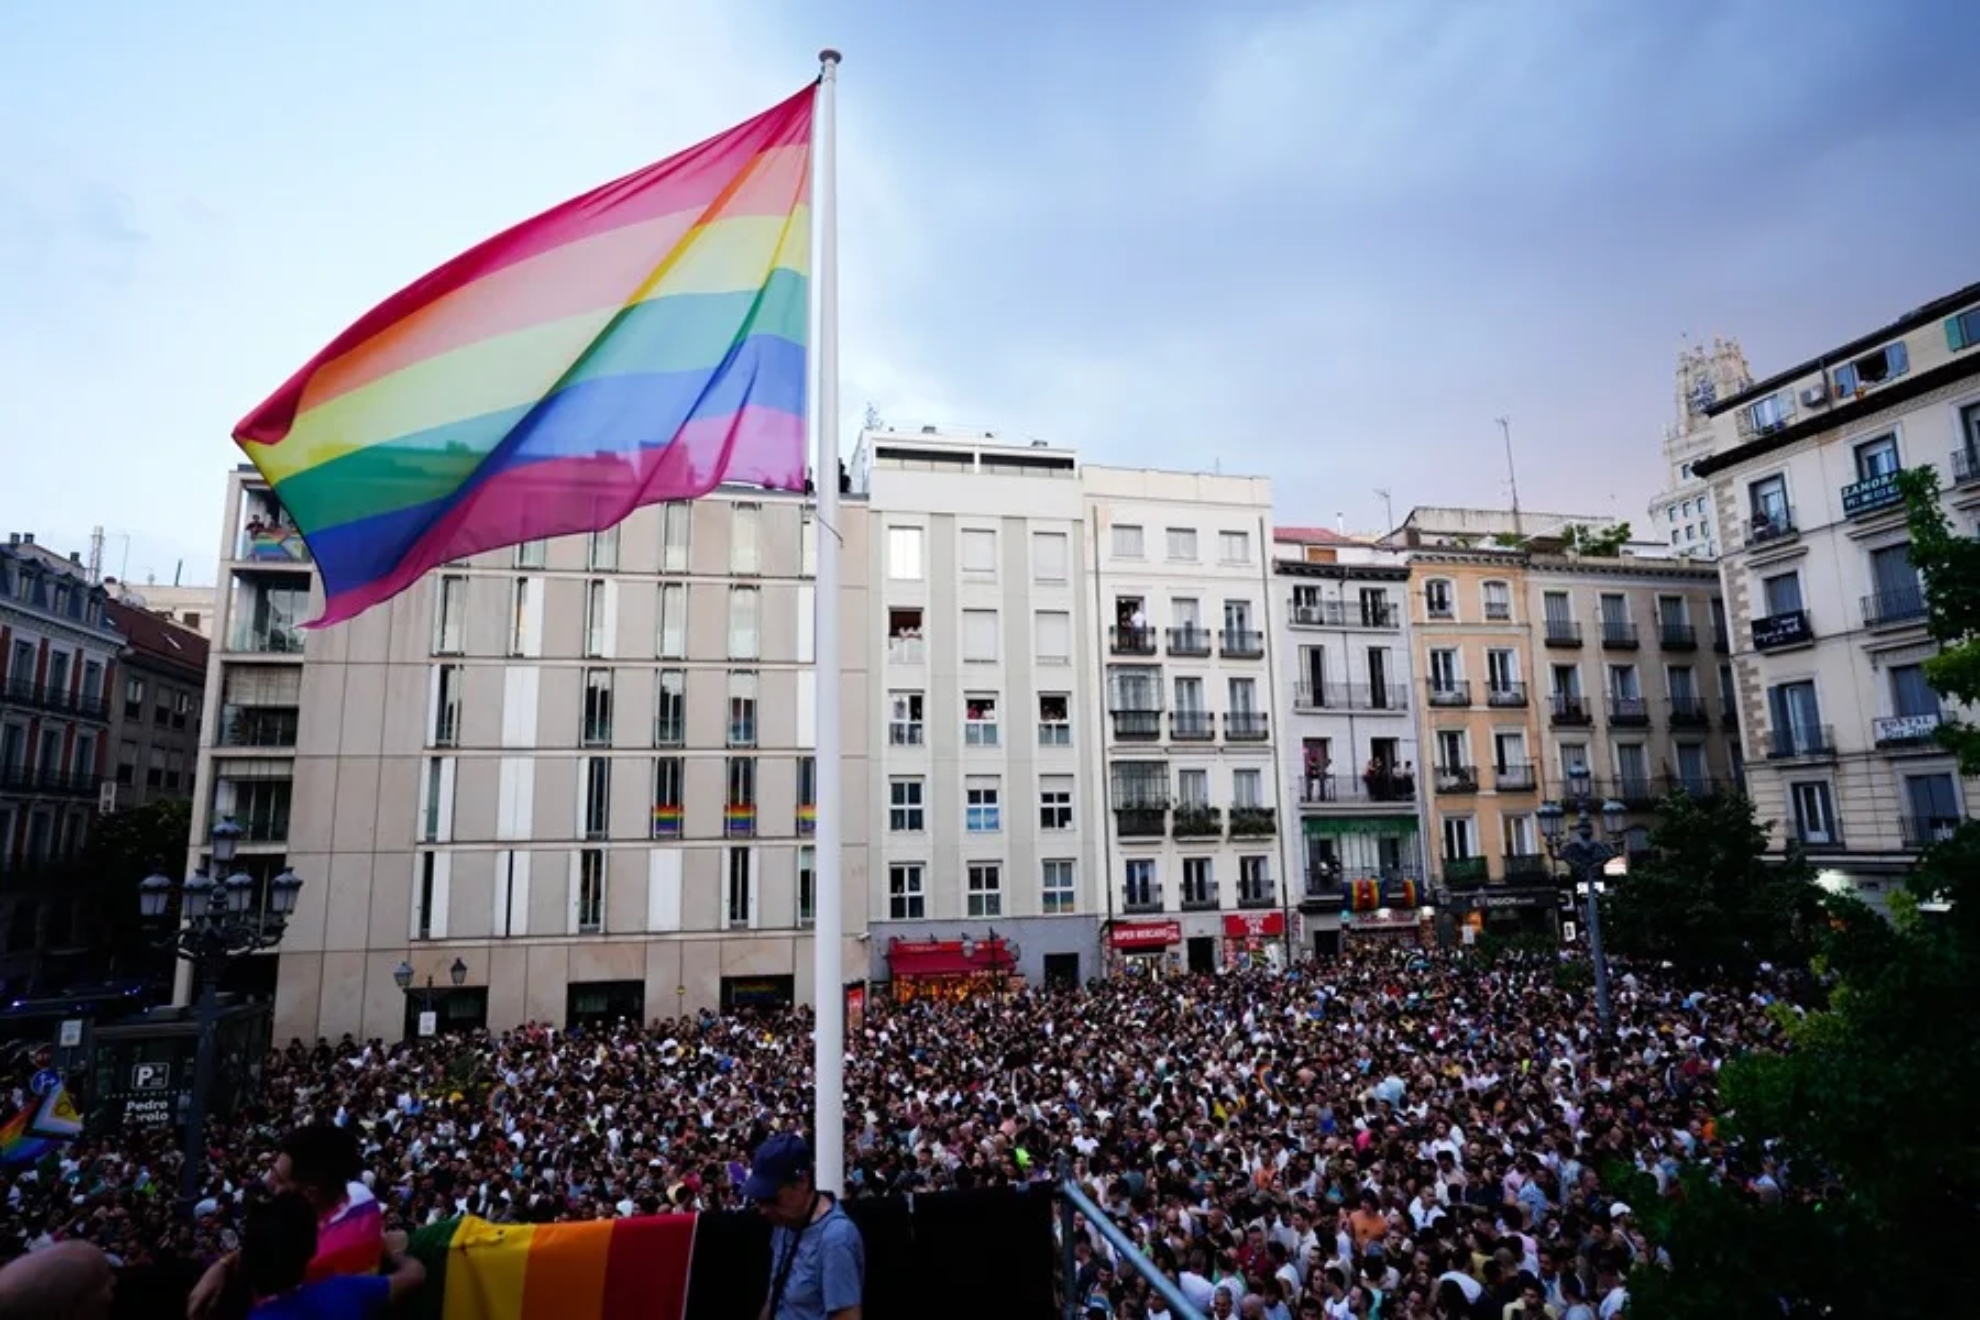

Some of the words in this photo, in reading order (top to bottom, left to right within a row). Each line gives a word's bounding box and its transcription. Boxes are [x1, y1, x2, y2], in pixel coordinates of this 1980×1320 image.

[1113, 929, 1136, 940] SUPER
[137, 1066, 154, 1087] P
[126, 1099, 169, 1112] Pedro
